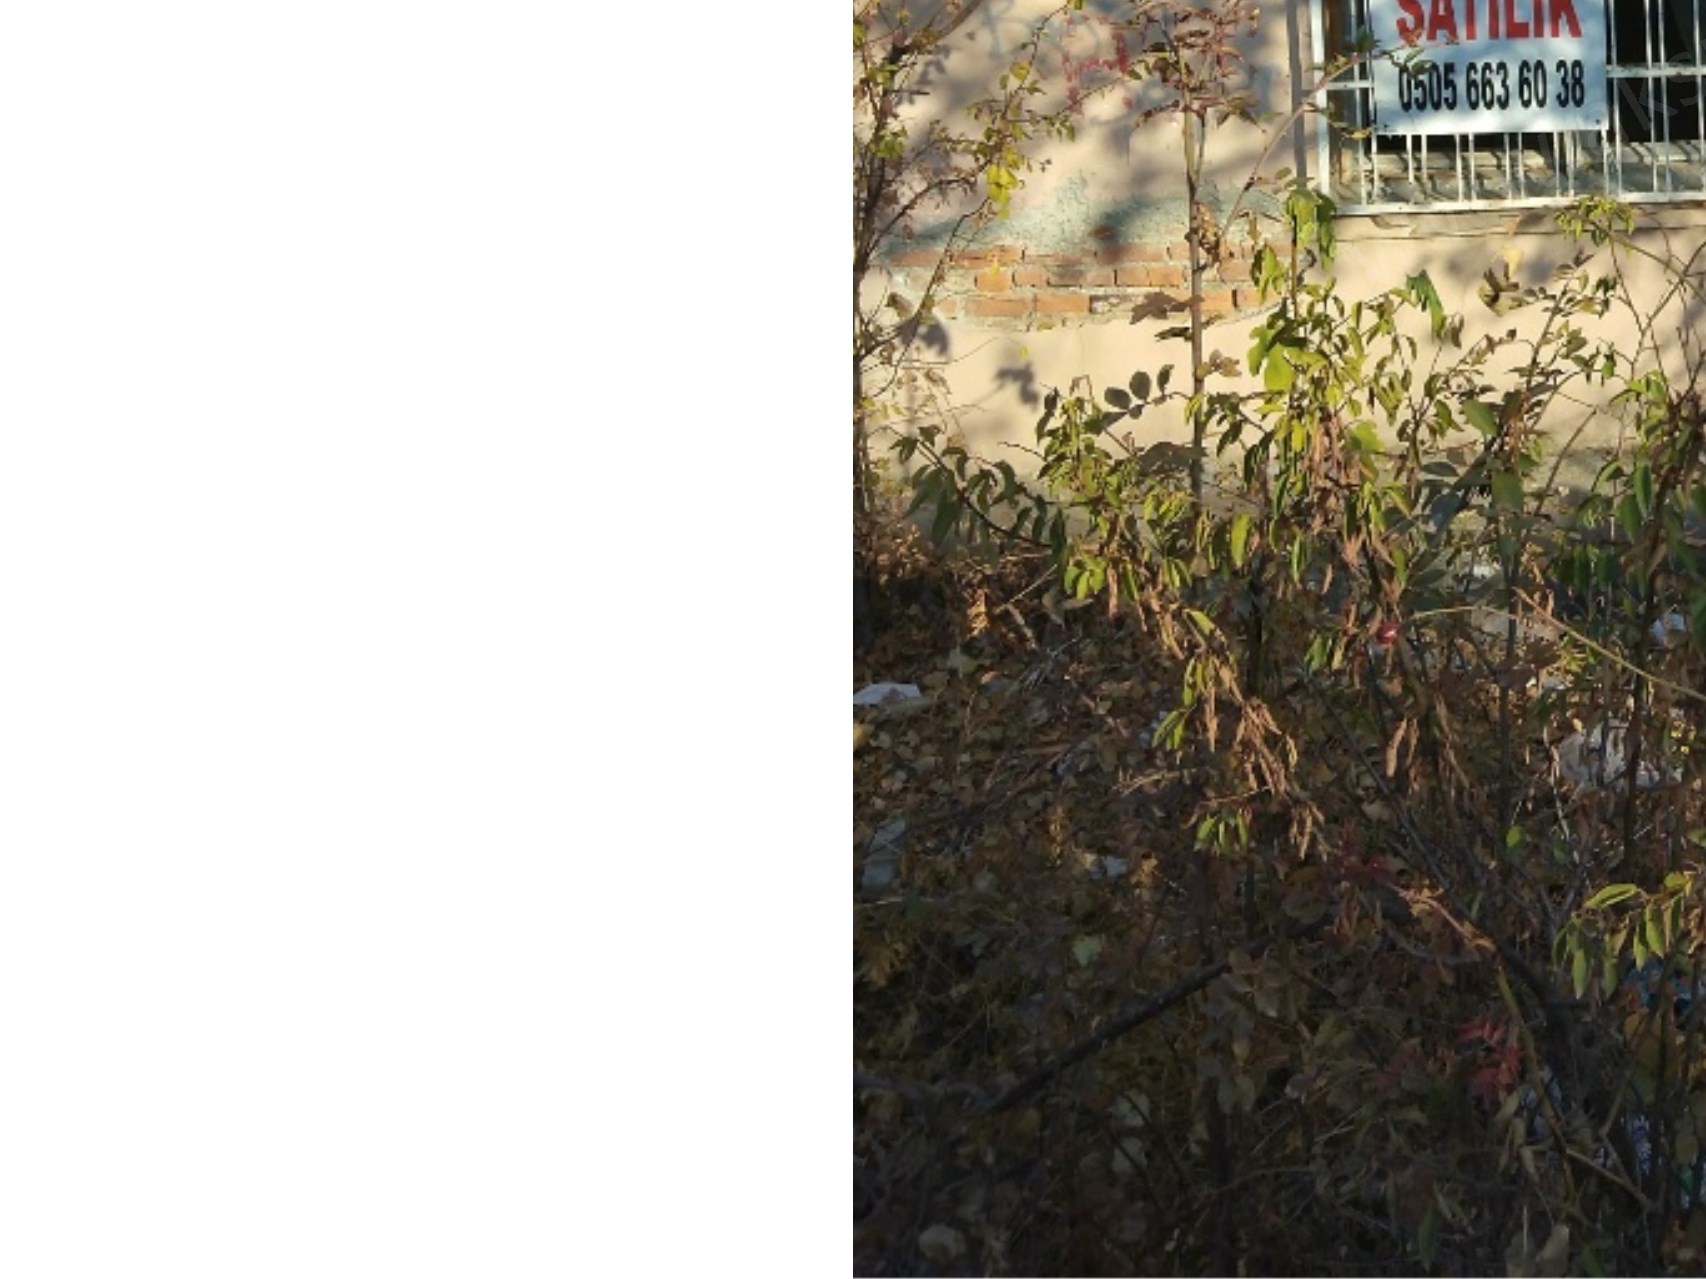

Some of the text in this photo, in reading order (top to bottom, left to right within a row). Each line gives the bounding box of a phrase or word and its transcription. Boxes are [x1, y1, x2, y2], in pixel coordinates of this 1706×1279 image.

[1399, 59, 1585, 112] 0505 663 60 38
